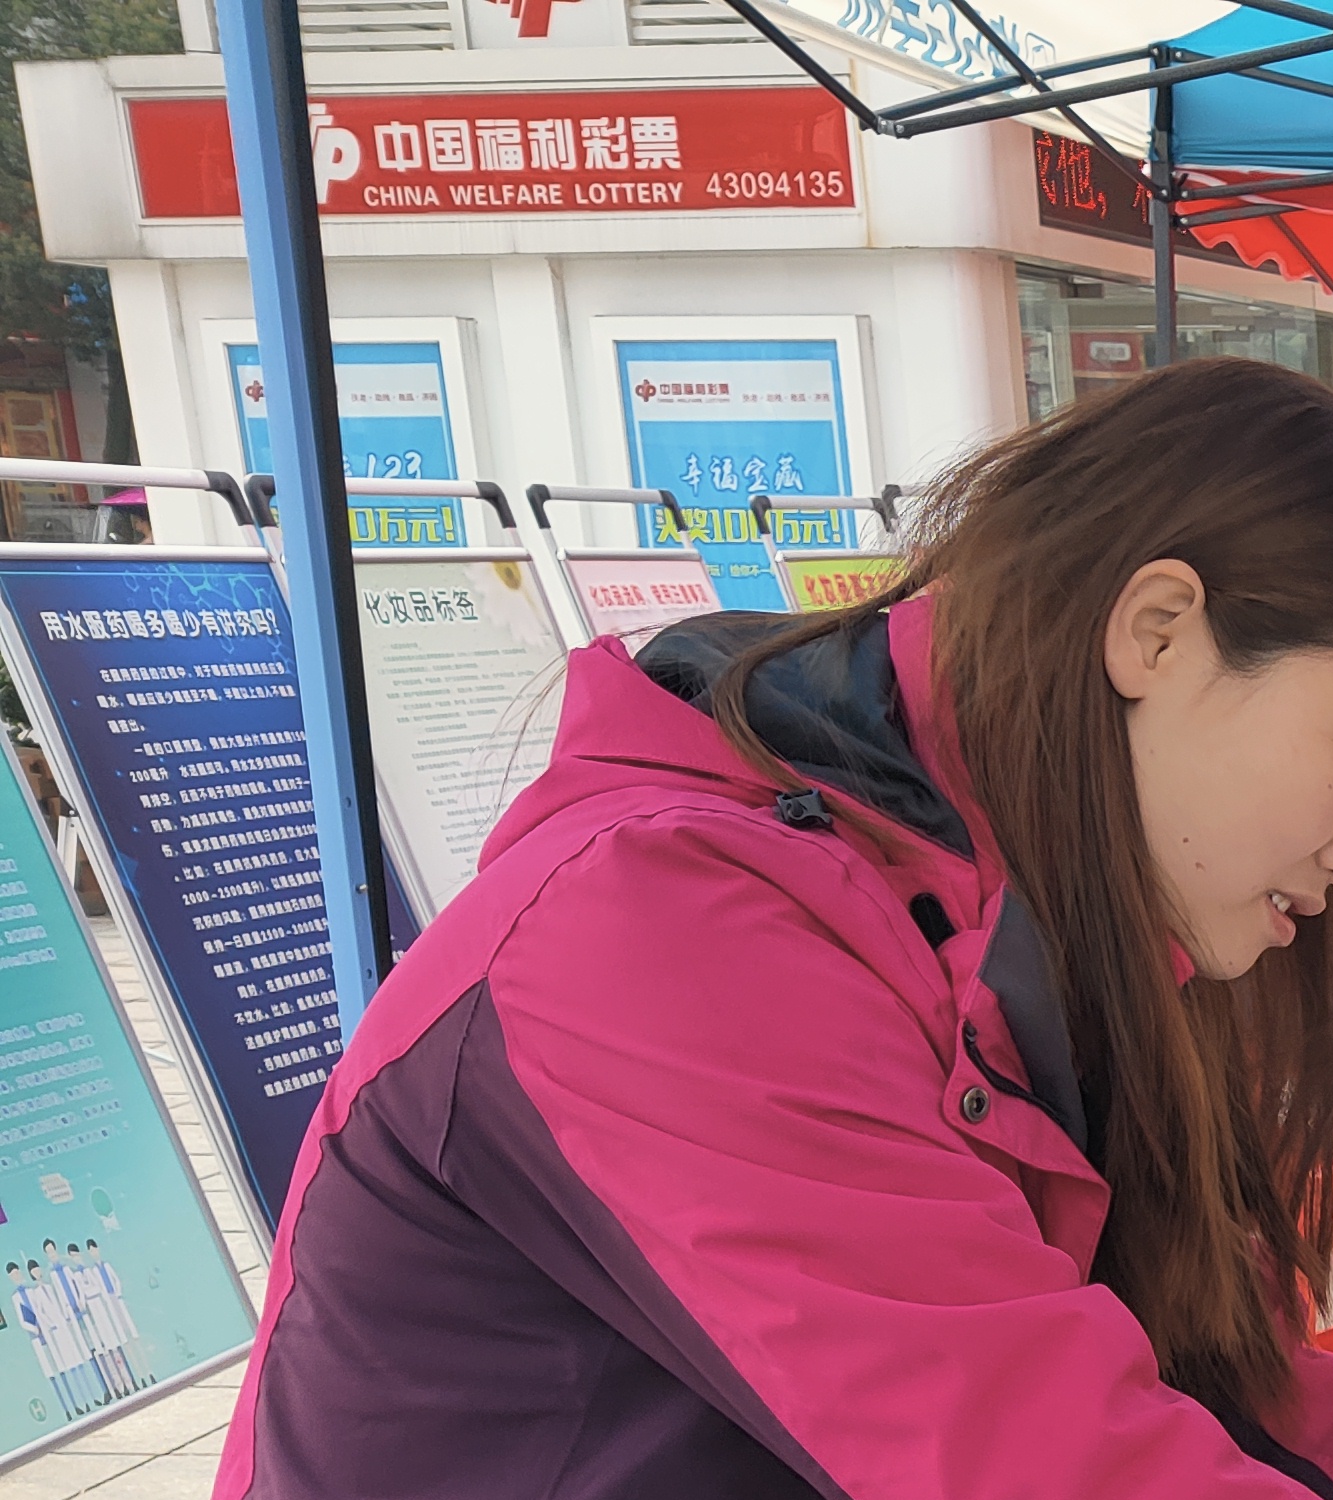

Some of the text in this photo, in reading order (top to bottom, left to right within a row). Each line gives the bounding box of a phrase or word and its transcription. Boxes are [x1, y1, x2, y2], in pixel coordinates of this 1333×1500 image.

[375, 117, 682, 173] 中国福利彩票
[363, 182, 684, 207] CHINA WELFARE LOTTERY
[705, 171, 844, 199] 43094135
[364, 590, 479, 625] 化妆品标签
